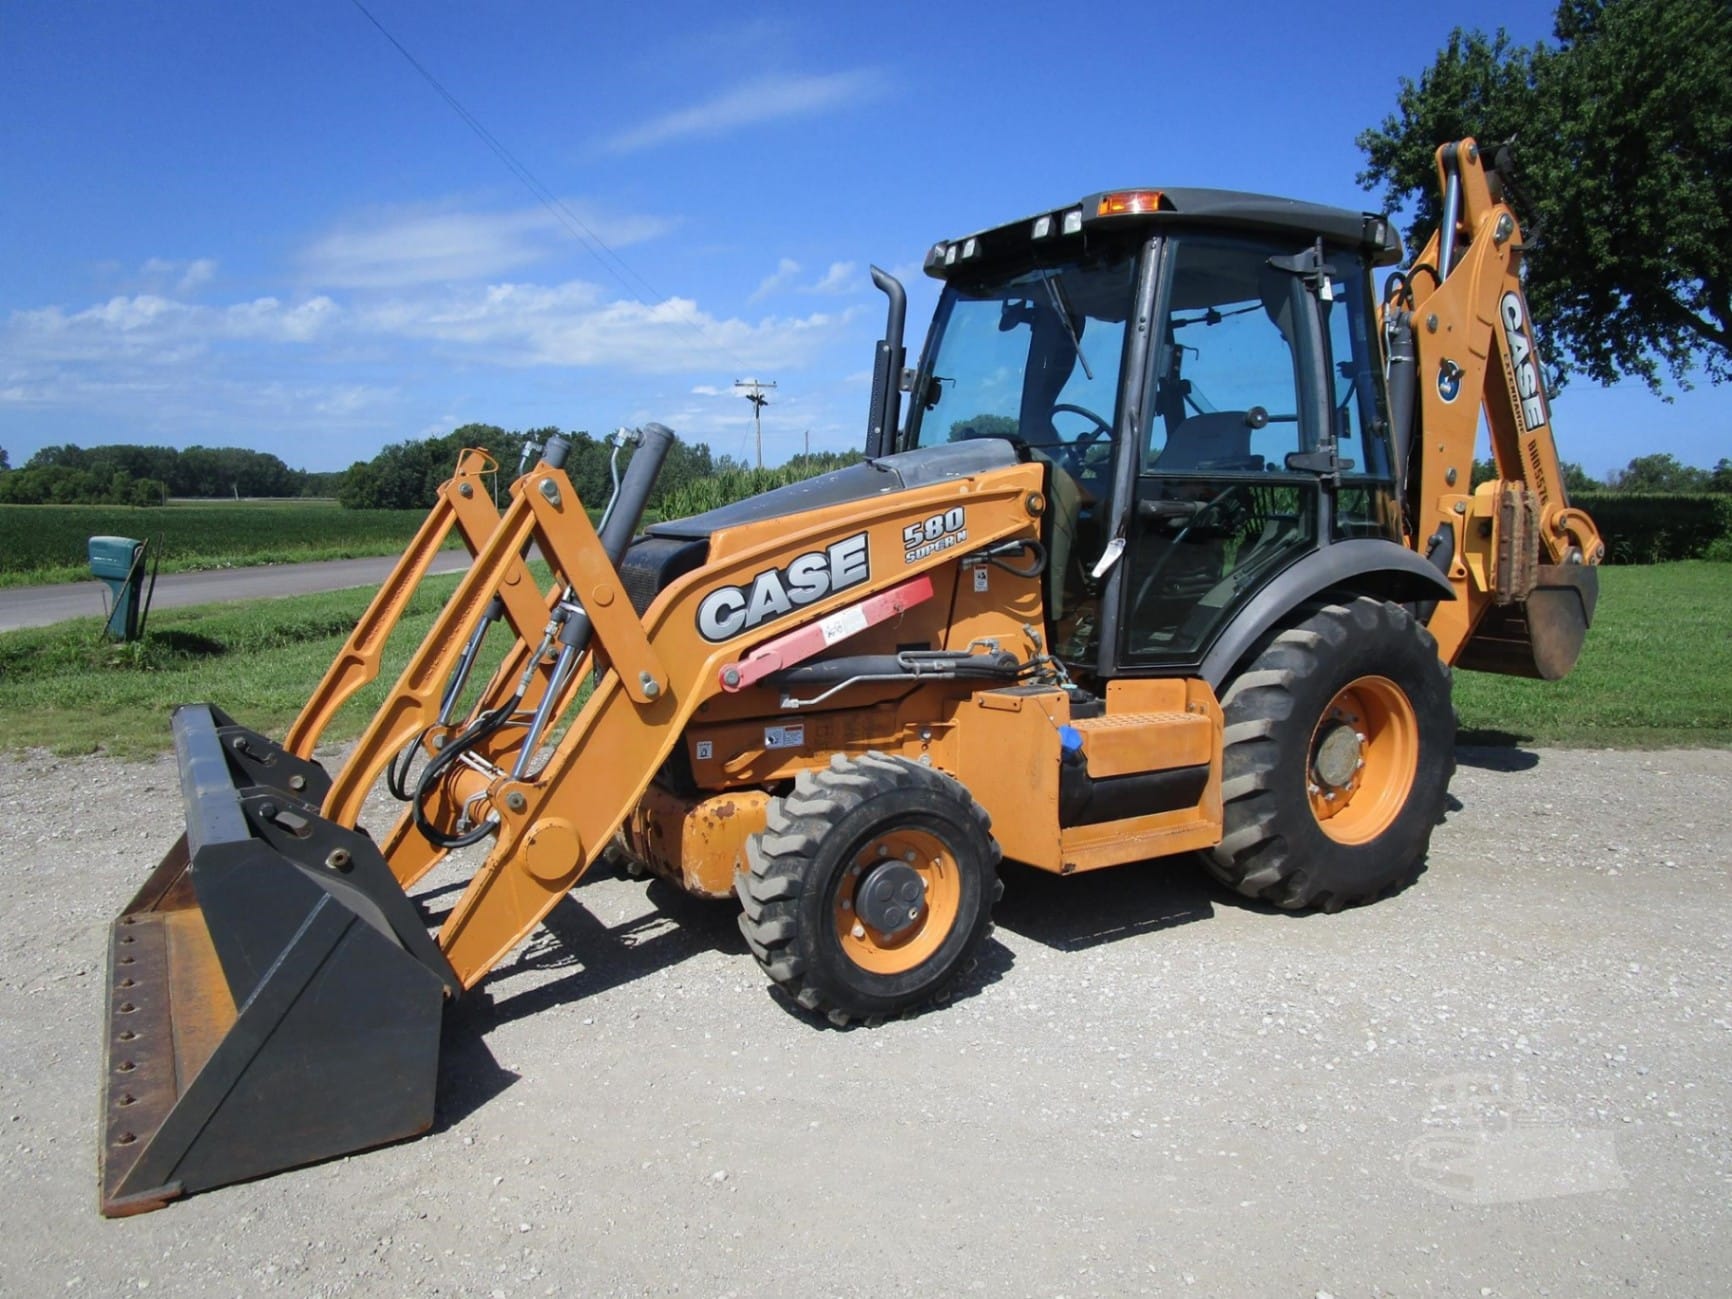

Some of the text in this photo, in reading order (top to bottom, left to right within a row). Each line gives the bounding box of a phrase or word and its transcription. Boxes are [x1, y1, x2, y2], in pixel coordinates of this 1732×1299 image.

[1501, 291, 1546, 432] CASE
[902, 506, 965, 551] 580
[904, 529, 968, 565] SUPER N
[698, 532, 869, 642] CASE
